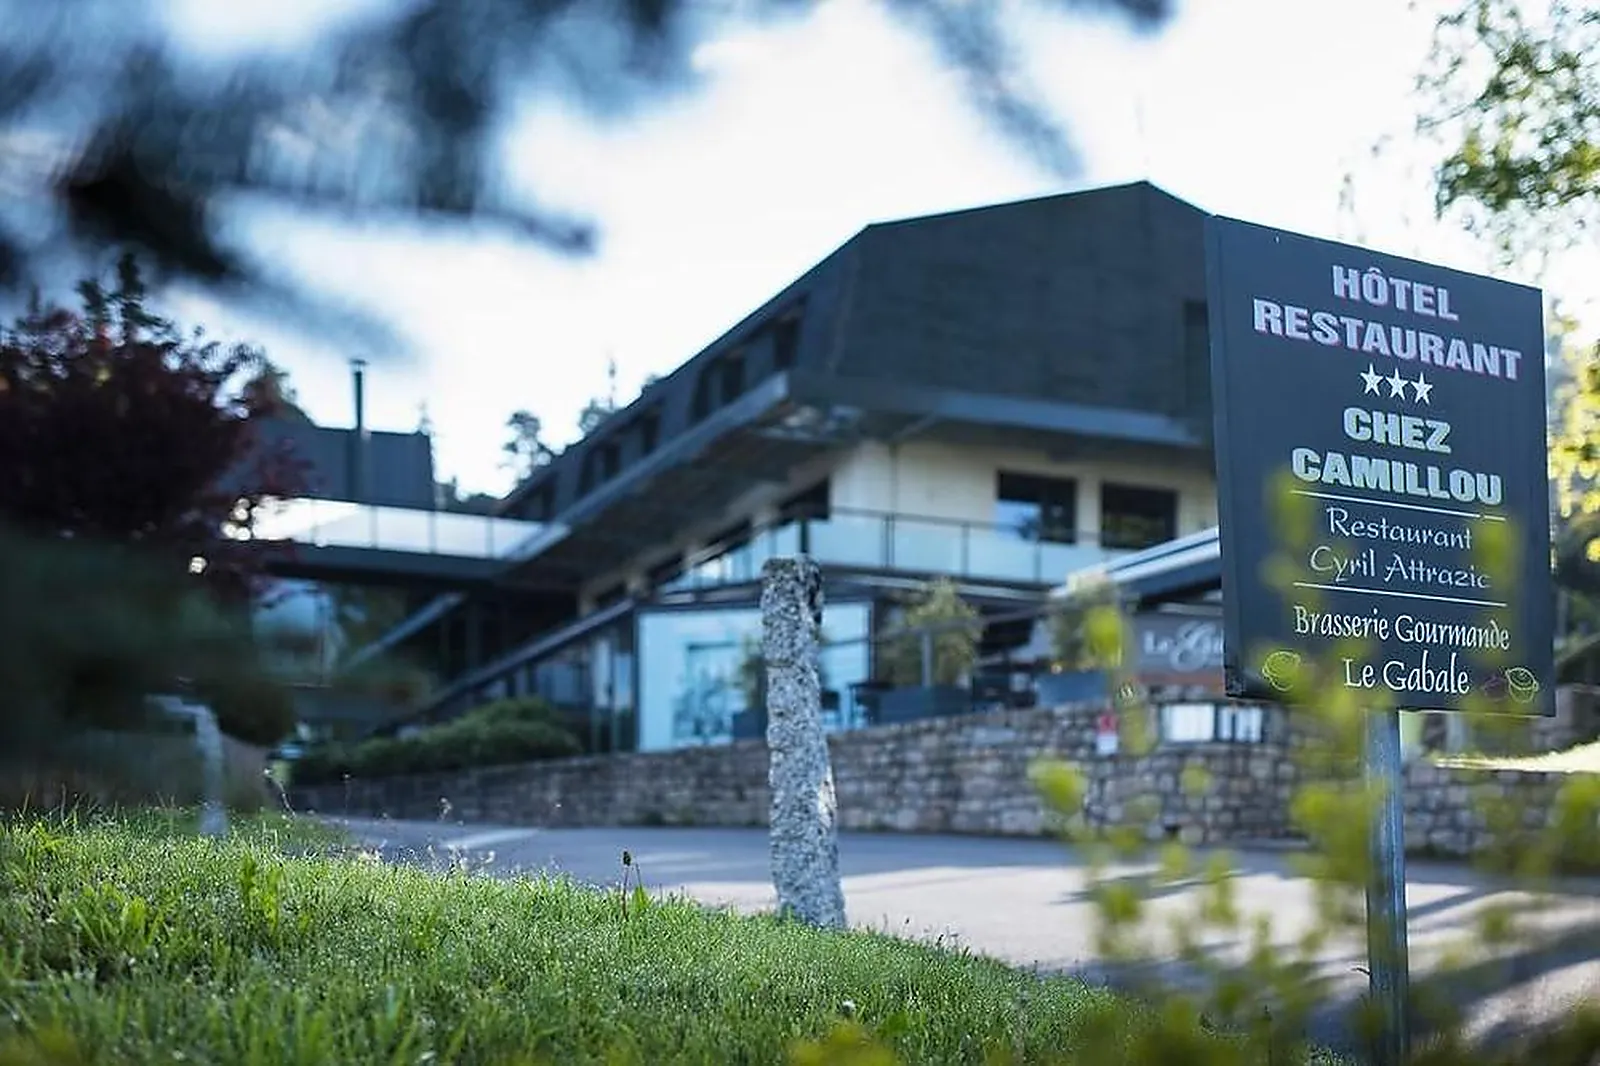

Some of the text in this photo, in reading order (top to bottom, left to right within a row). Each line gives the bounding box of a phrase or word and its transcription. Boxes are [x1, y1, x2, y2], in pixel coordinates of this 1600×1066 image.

[1331, 266, 1459, 322] HÔTEL
[1253, 298, 1522, 380] RESTAURANT
[1343, 407, 1452, 454] CHEZ
[1292, 447, 1502, 506] CAMILLOU
[1326, 506, 1472, 551] Restaurant
[1310, 545, 1491, 589] Cyril Attrazic
[1293, 605, 1510, 650] Brasserie Gourmande
[1342, 650, 1470, 694] Le Gabale
